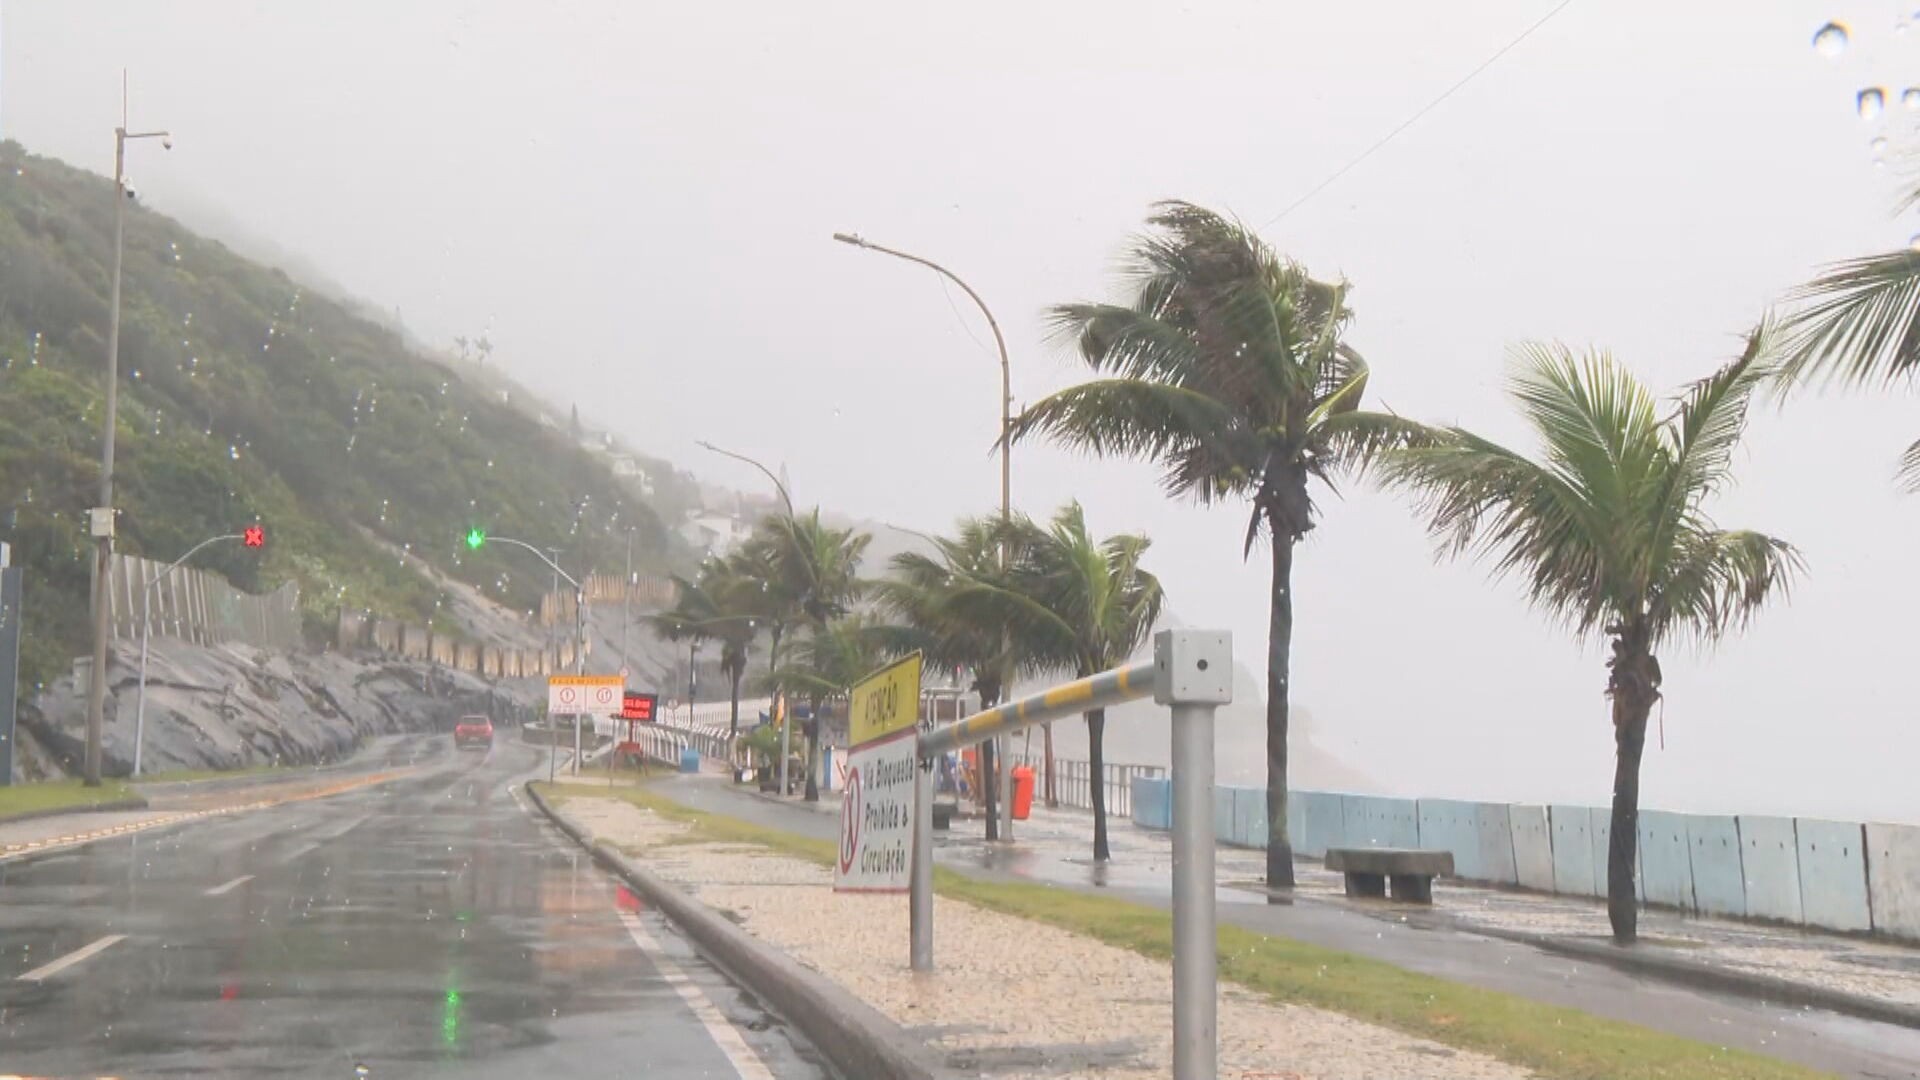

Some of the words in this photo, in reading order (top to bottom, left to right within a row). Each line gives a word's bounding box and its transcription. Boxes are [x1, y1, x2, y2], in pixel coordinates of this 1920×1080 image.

[864, 675, 898, 731] ATENÇÃO
[863, 761, 874, 791] Via
[876, 752, 913, 792] Bloqueada
[864, 798, 898, 832] Proibida
[861, 839, 905, 881] Circulação
